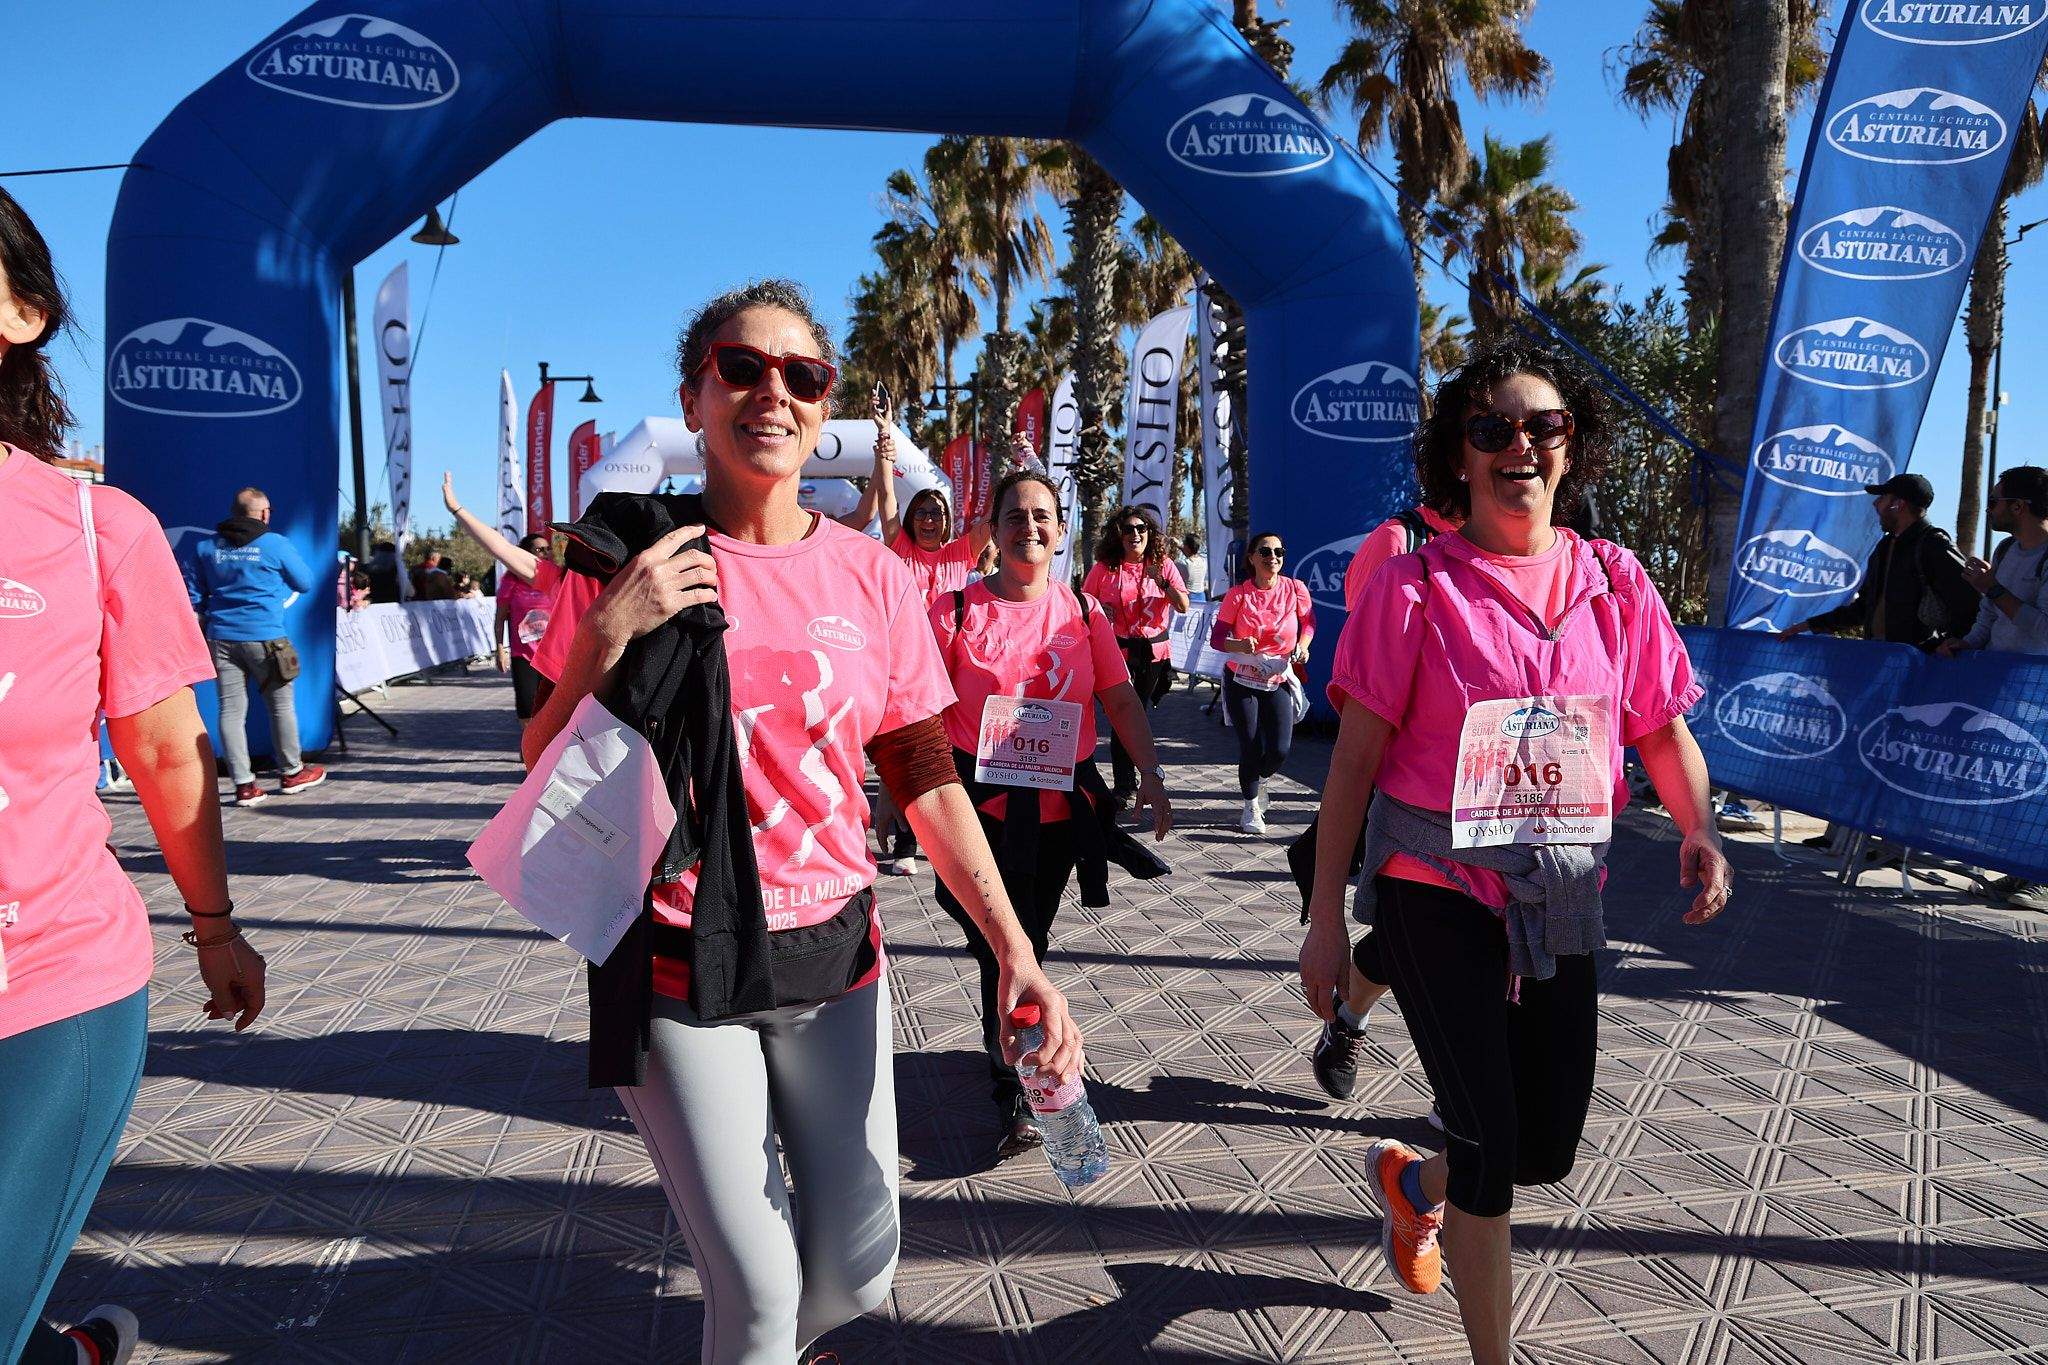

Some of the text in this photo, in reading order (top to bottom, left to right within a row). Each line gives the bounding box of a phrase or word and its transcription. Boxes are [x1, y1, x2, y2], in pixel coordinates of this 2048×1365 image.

[1872, 0, 2031, 25] ASTURIANA
[258, 48, 443, 94] ASTURIANA
[1869, 112, 1989, 126] CENTRAL LECHERA
[1180, 125, 1326, 156] ASTURIANA
[1836, 114, 1989, 150] ASTURIANA
[1808, 231, 1950, 267] ASTURIANA
[1839, 230, 1950, 245] CENTRAL LECHERA
[1785, 339, 1912, 378] ASTURIANA
[114, 354, 288, 400] ASTURIANA
[532, 409, 546, 493] Santander
[604, 463, 651, 474] OYSHO
[1763, 443, 1880, 485] ASTURIANA
[953, 456, 964, 516] Santander
[813, 623, 862, 647] ASTURIANA
[1504, 719, 1556, 732] ASTURIANA
[1723, 695, 1832, 746] ASTURIANA
[1013, 737, 1050, 753] 016
[1867, 721, 2033, 791] ASTURIANA
[1019, 755, 1037, 763] 3193
[987, 771, 1018, 780] OYSHO
[1503, 762, 1563, 786] 016
[1514, 793, 1543, 804] 3186
[1470, 810, 1500, 818] CARRERA
[1525, 807, 1550, 815] MUJER
[1557, 806, 1591, 815] VALENCIA
[1468, 824, 1595, 838] OYSHO Santander
[764, 873, 863, 911] DE LA MUJER
[766, 911, 798, 930] 2025
